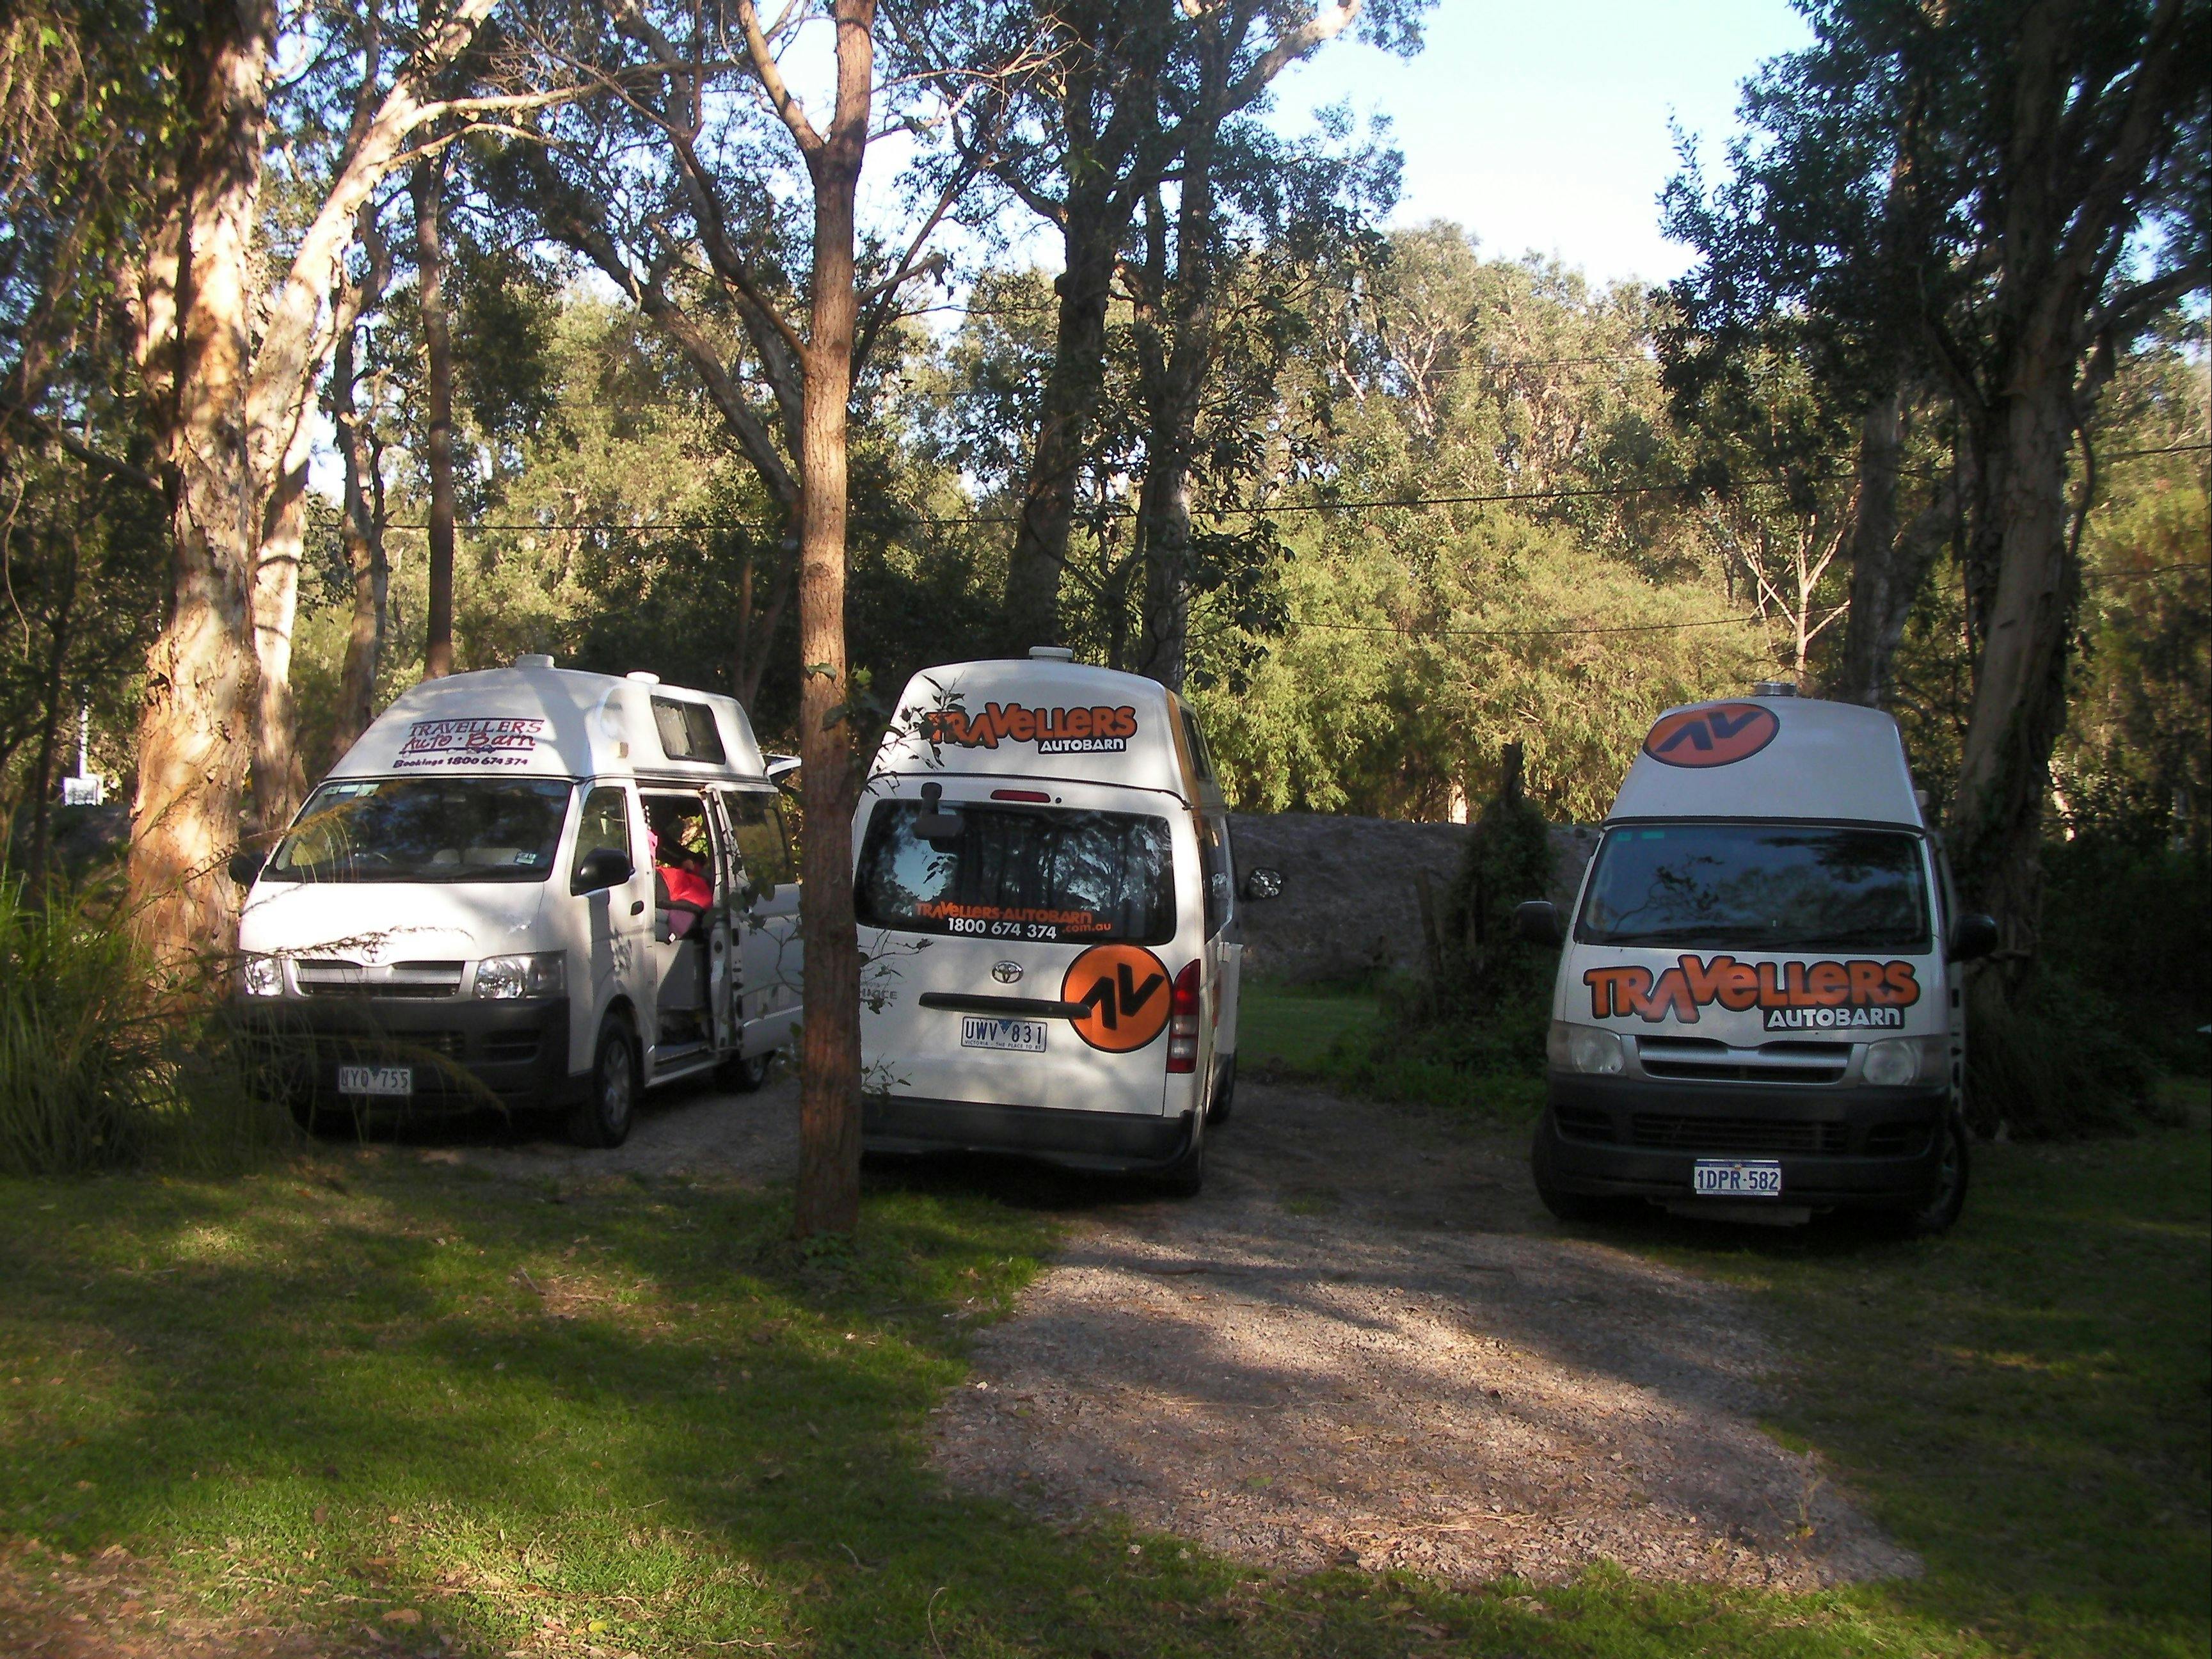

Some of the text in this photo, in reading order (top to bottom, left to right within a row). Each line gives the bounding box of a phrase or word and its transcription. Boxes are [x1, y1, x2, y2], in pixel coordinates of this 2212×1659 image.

[408, 721, 542, 737] TRAVELLERS
[465, 732, 536, 747] Barn
[393, 758, 444, 768] Bookings
[447, 757, 479, 765] 1800
[948, 917, 1056, 940] 1800 674 374
[966, 1020, 1042, 1045] UWV 831
[381, 1071, 408, 1089] 755
